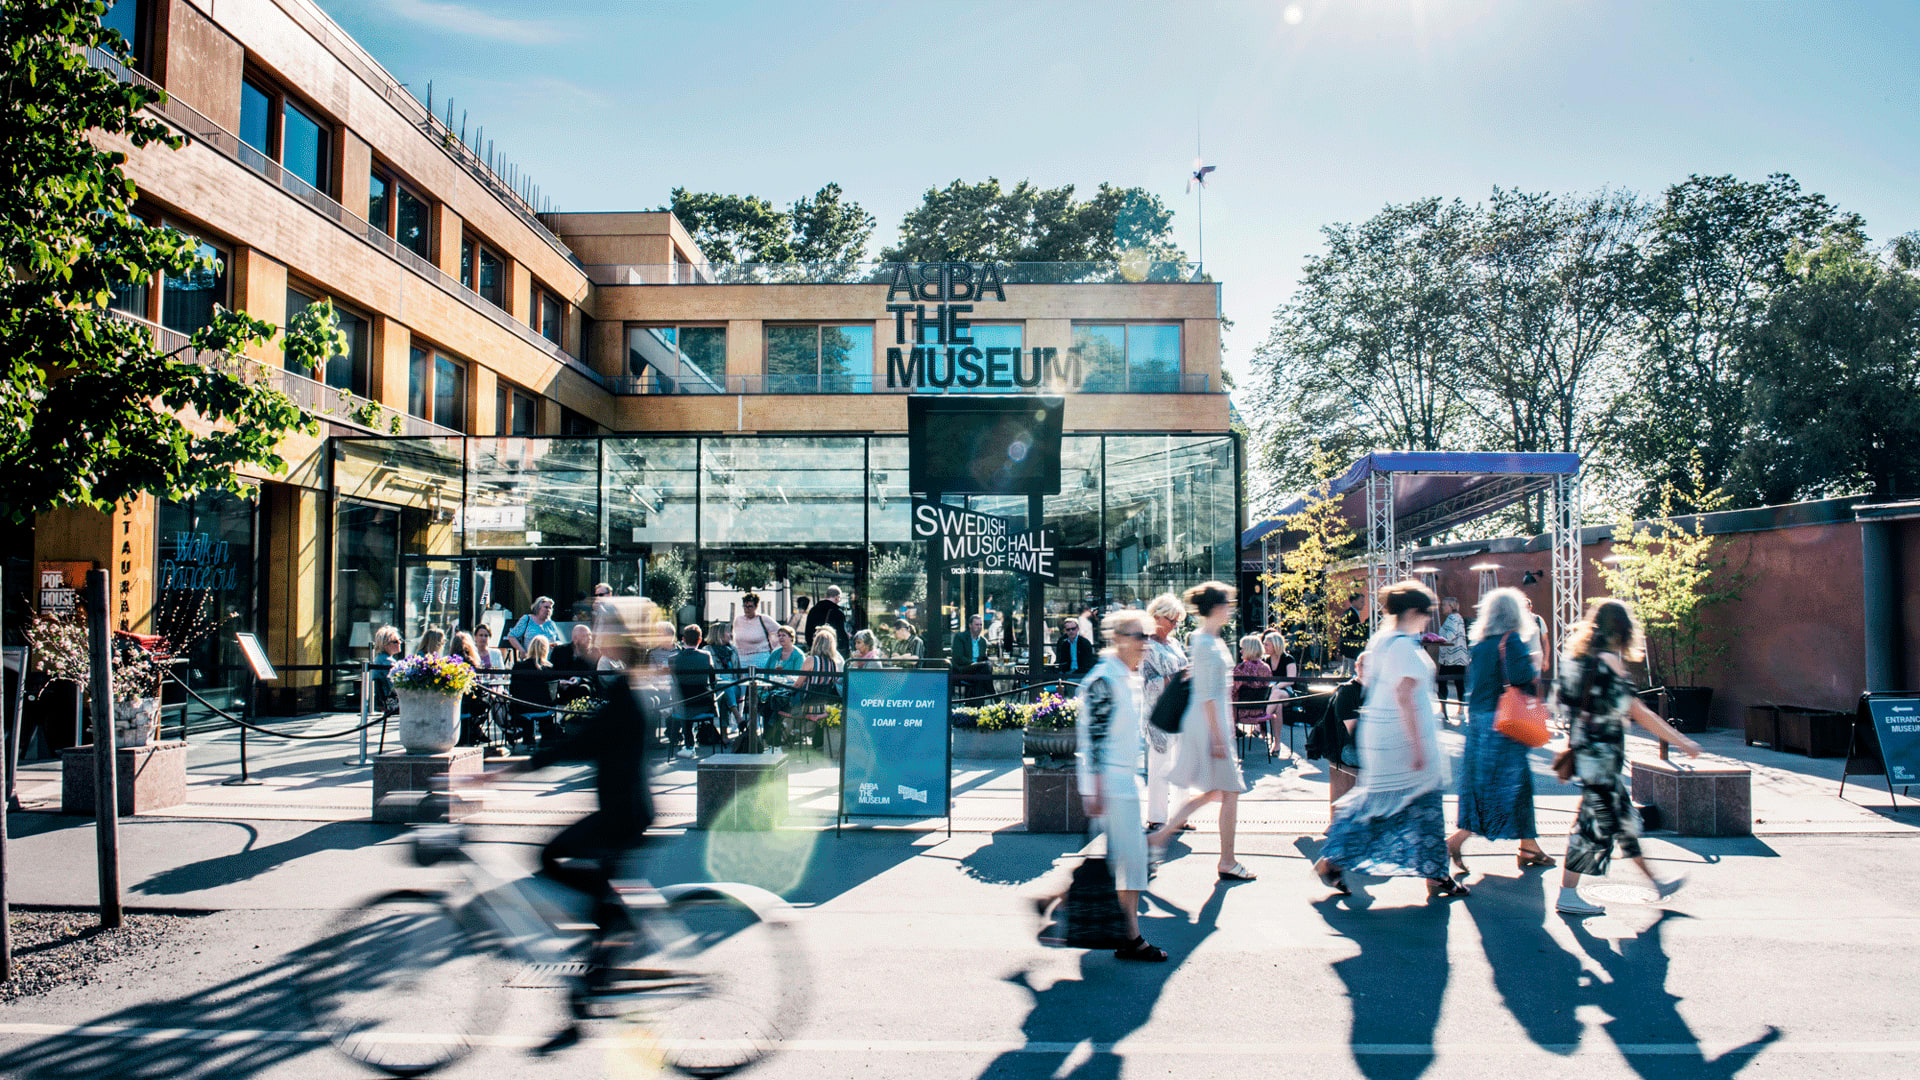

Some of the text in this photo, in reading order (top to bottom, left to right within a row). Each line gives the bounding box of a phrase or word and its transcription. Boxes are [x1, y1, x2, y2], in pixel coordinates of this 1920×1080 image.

[886, 262, 1006, 301] ABBA
[885, 304, 974, 344] THE
[886, 347, 1082, 388] MUSEUM
[915, 504, 1006, 537] SWEDISH
[943, 530, 1054, 561] MUSIC HALL
[985, 551, 1055, 578] OF FAME
[41, 574, 63, 588] POP
[41, 591, 76, 606] HOUSE
[860, 698, 936, 708] OPEN EVERY DAY!
[871, 718, 896, 727] 10AM
[903, 718, 923, 727] 8PM
